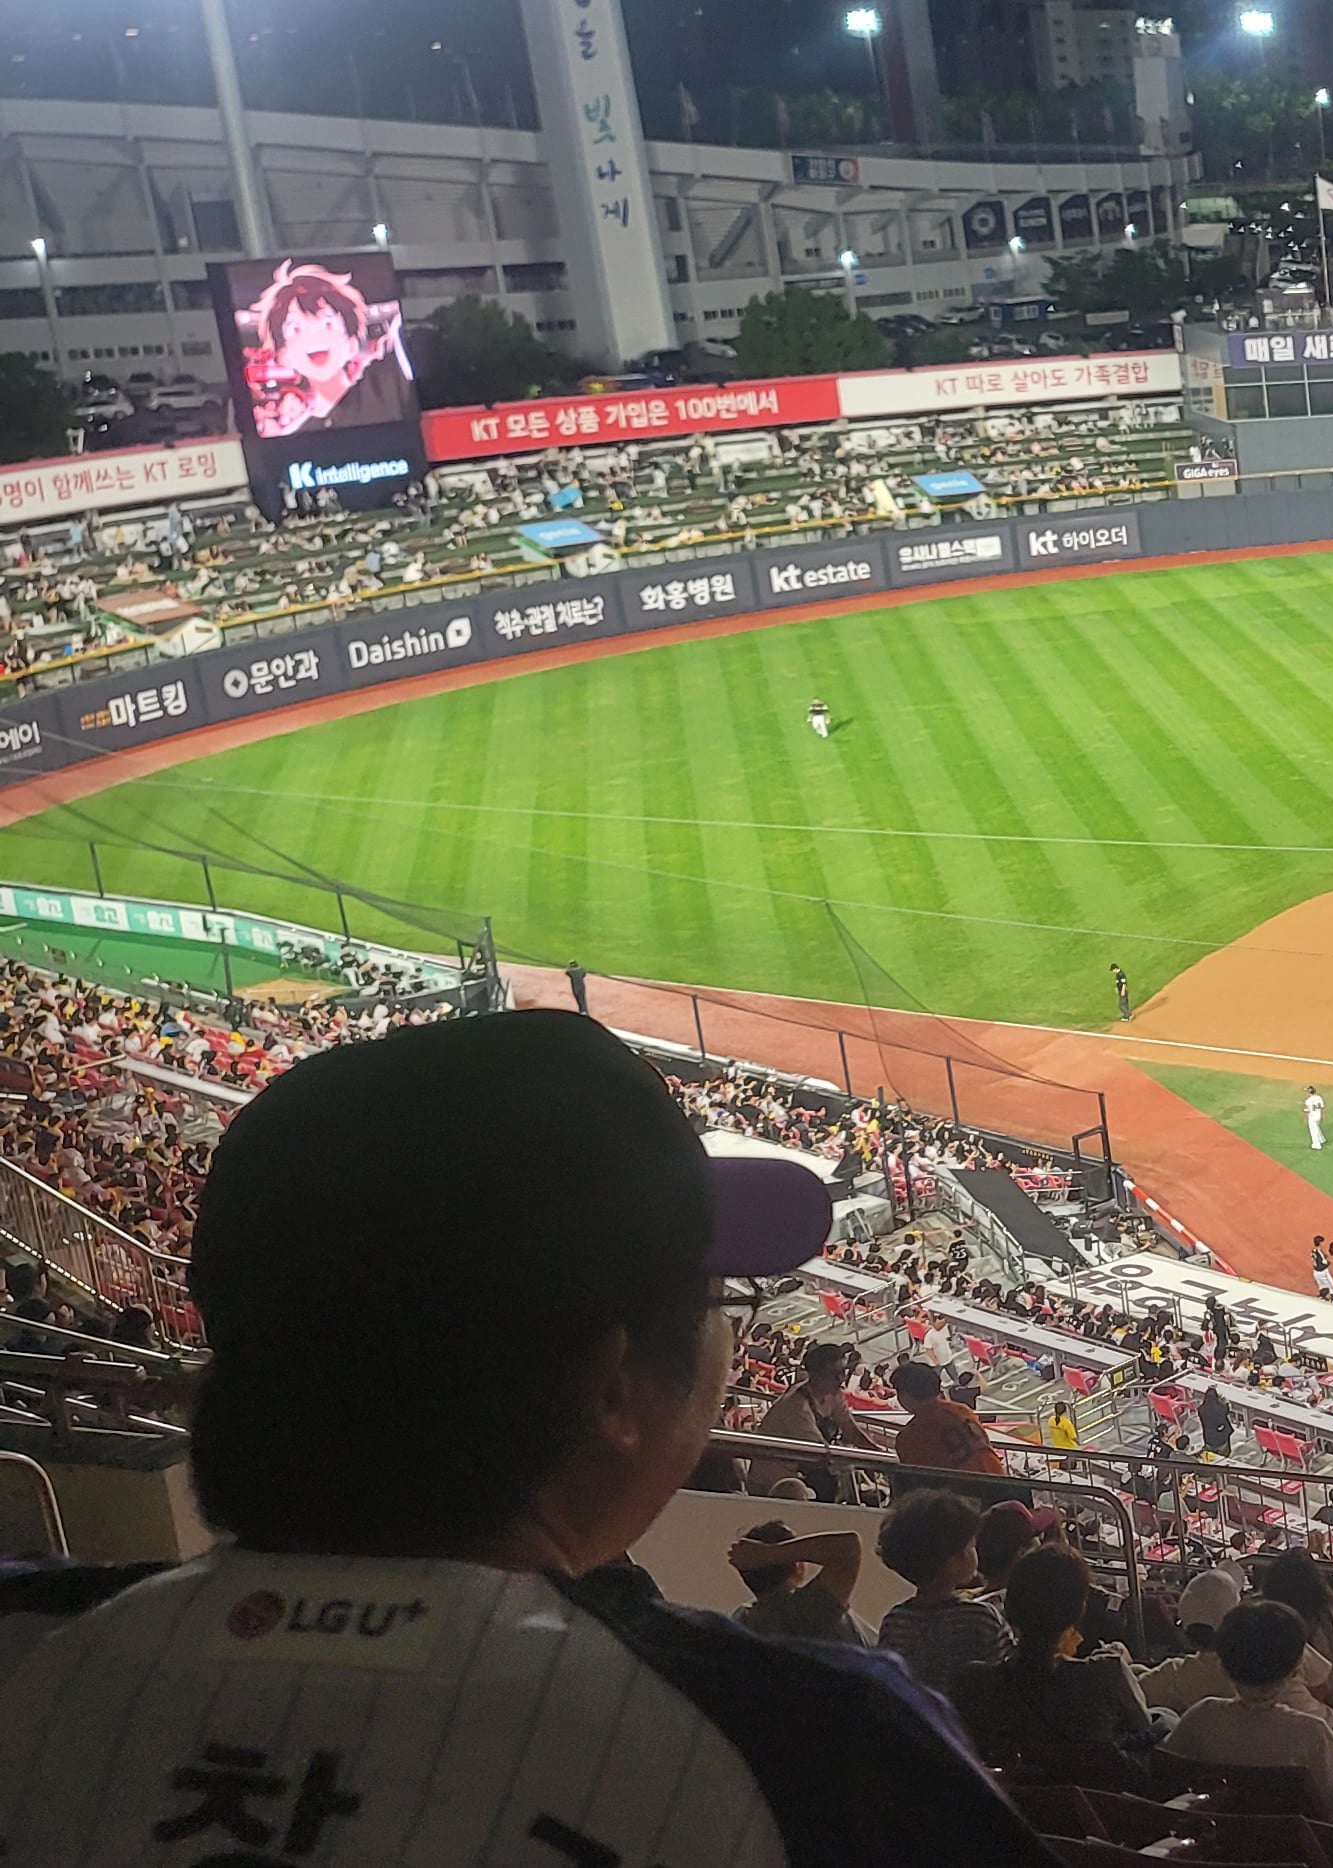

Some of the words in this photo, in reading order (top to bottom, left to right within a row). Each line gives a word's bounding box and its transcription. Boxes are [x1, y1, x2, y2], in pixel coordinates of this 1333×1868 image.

[1244, 336, 1296, 362] 매일
[935, 378, 958, 396] KT
[965, 373, 1004, 395] 따로
[1010, 367, 1067, 393] 살아도
[1075, 361, 1150, 387] 가족결합
[470, 417, 500, 442] KT
[506, 414, 549, 439] 모든
[555, 405, 600, 436] 상품
[604, 399, 669, 429] 가입은
[0, 475, 46, 509] 명이
[51, 463, 137, 501] 함께쓰는
[143, 460, 169, 484] KT
[177, 452, 218, 480] 로밍
[289, 462, 316, 490] K
[1029, 528, 1060, 557] kt
[1061, 524, 1128, 552] 하이오더
[639, 573, 736, 612] 화홍병원
[770, 566, 804, 594] kt
[803, 560, 872, 588] estate
[348, 627, 446, 669] Daishin
[250, 649, 319, 695] 문안과
[109, 680, 188, 728] 마트킹
[0, 721, 41, 751] 에이
